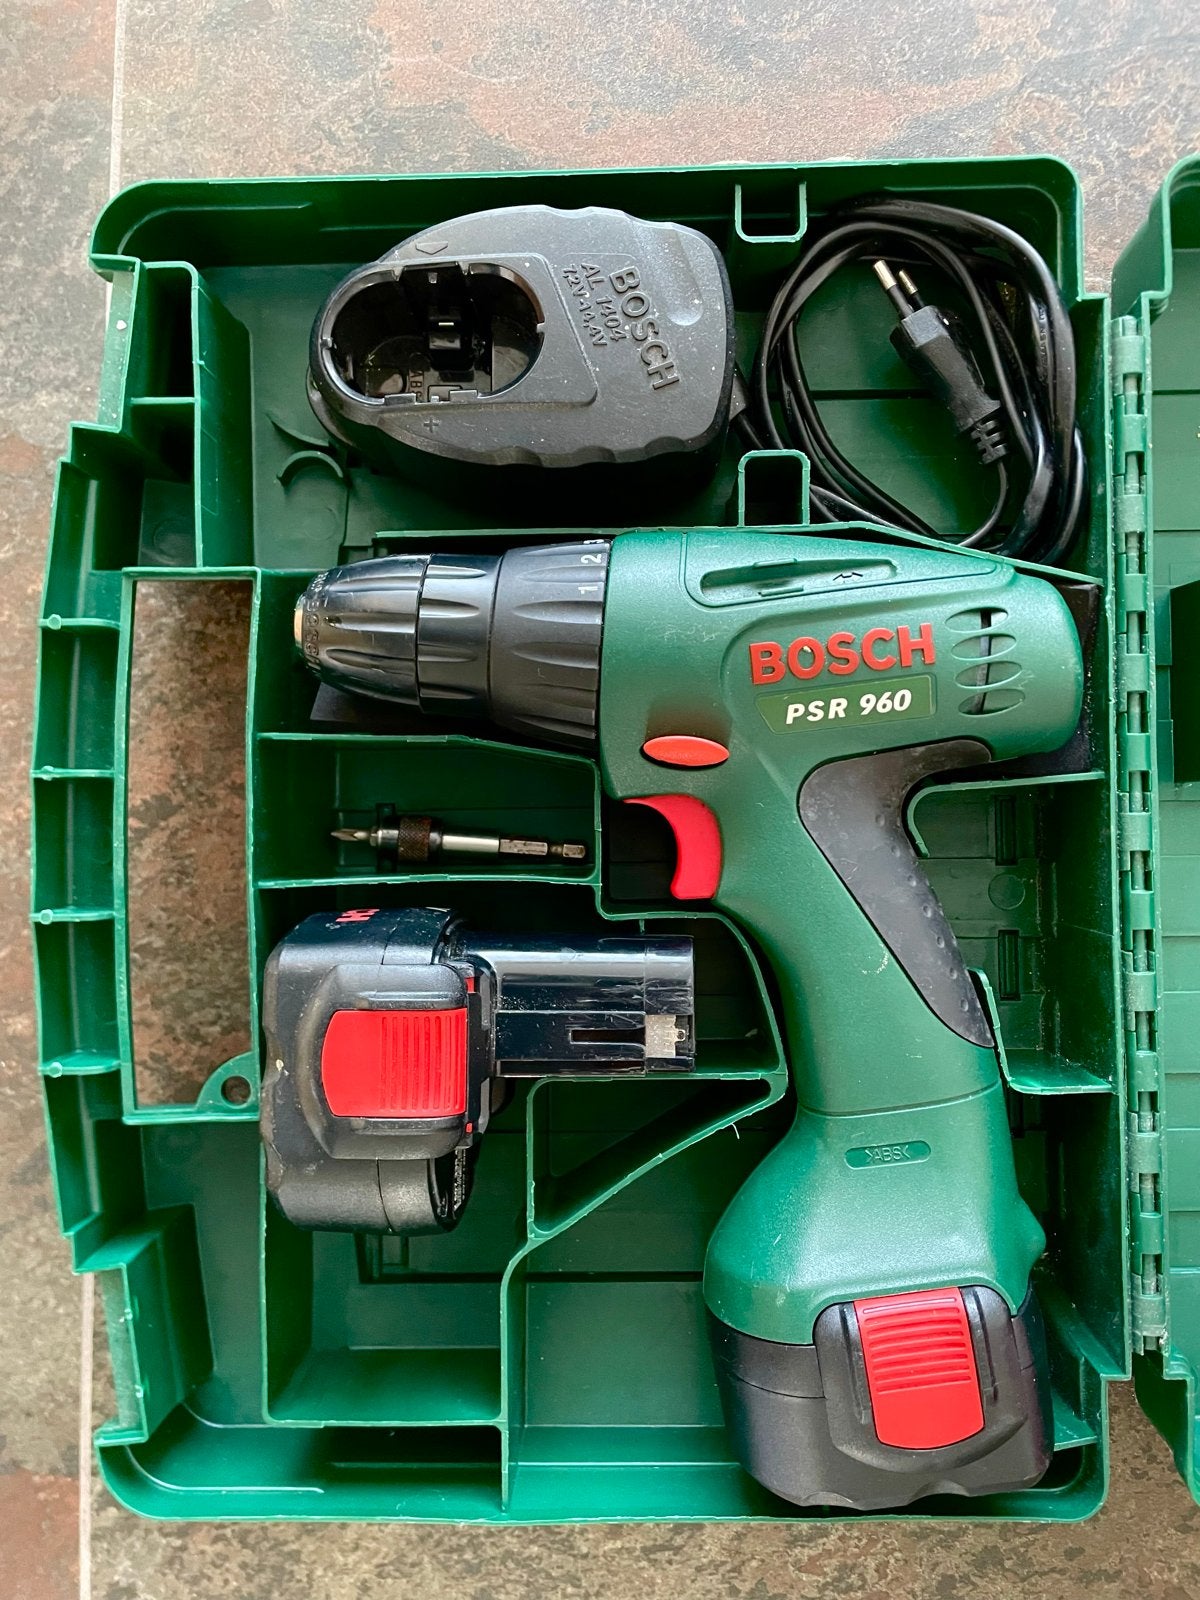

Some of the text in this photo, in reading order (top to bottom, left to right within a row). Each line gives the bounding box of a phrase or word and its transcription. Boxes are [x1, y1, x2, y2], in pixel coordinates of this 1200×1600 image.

[580, 262, 627, 342] AL 1404
[608, 265, 680, 390] BOSCH
[580, 553, 602, 564] 2
[578, 586, 598, 595] 1
[748, 622, 936, 686] BOSCH
[785, 688, 912, 725] PSR 960
